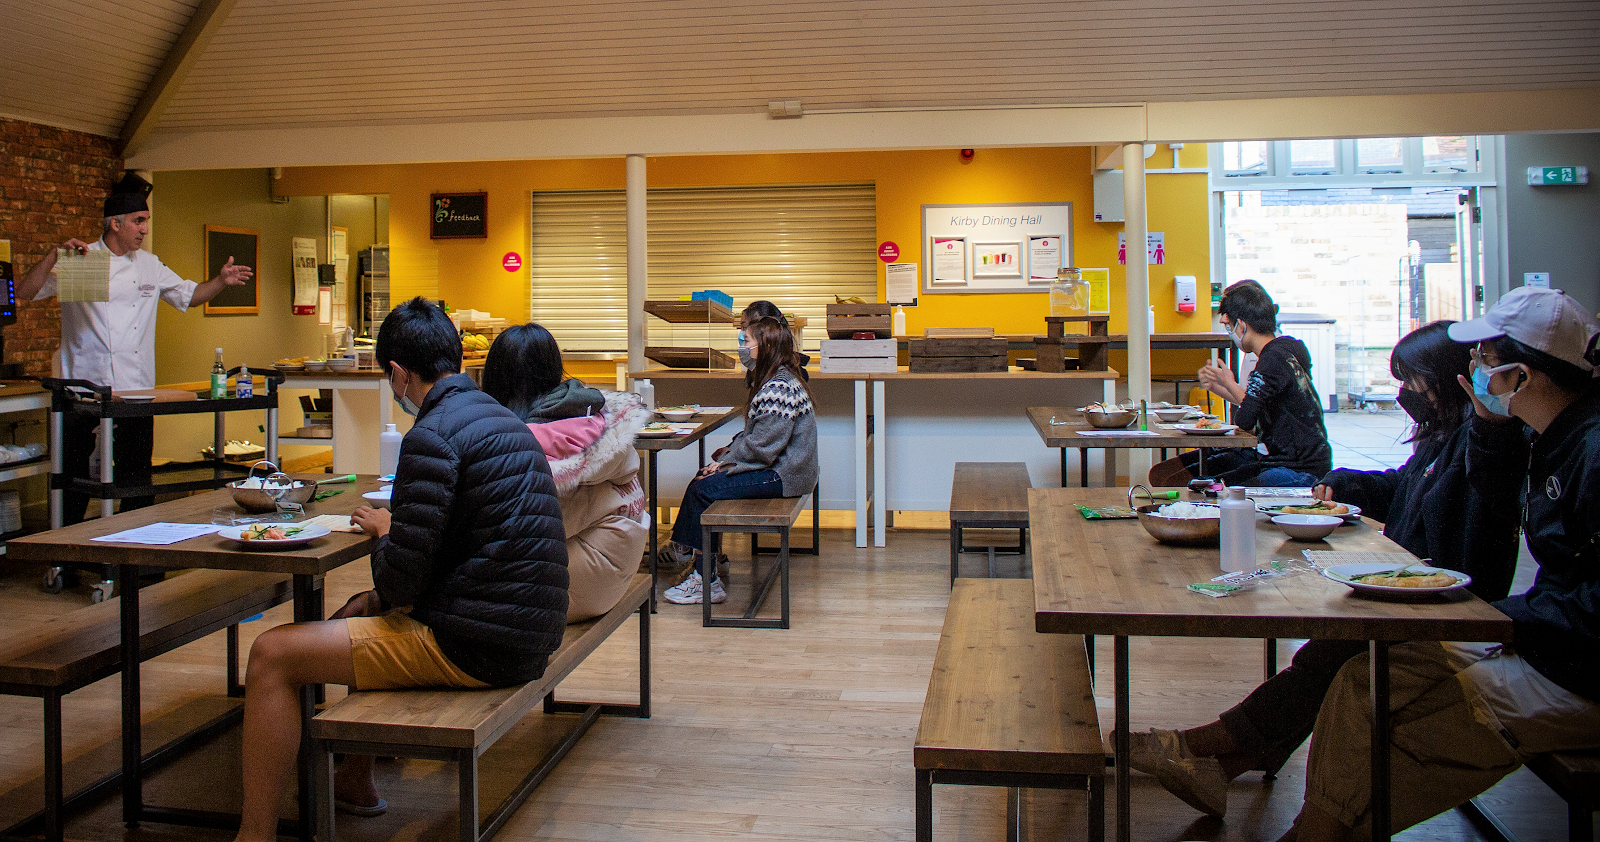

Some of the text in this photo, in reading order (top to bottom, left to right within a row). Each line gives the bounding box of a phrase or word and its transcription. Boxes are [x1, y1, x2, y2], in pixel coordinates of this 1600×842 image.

[950, 214, 1043, 228] Kirby Dining Hall
